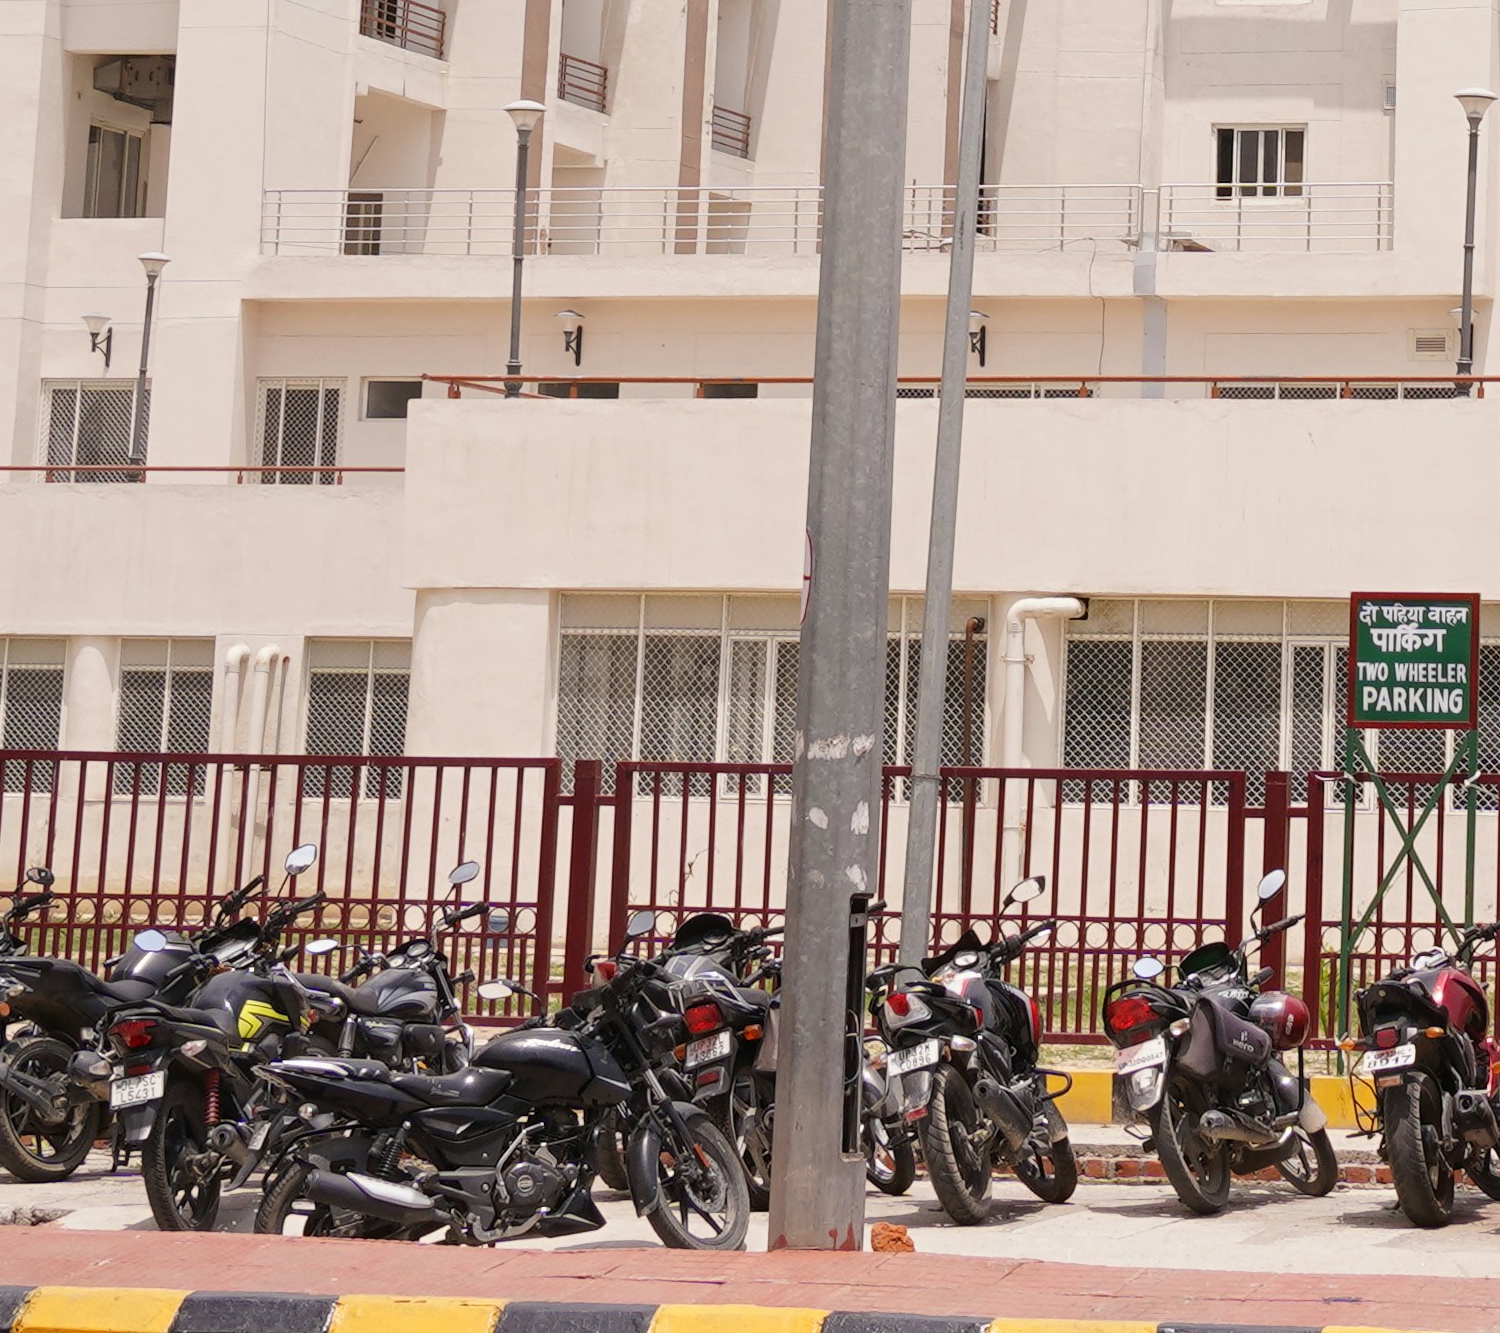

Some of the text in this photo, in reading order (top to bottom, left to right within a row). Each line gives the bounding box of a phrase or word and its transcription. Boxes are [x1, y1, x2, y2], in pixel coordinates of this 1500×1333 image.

[1359, 602, 1469, 626] दो पहिया वाहन
[1357, 662, 1467, 684] TWO WHEELER
[1362, 686, 1463, 714] PARKING
